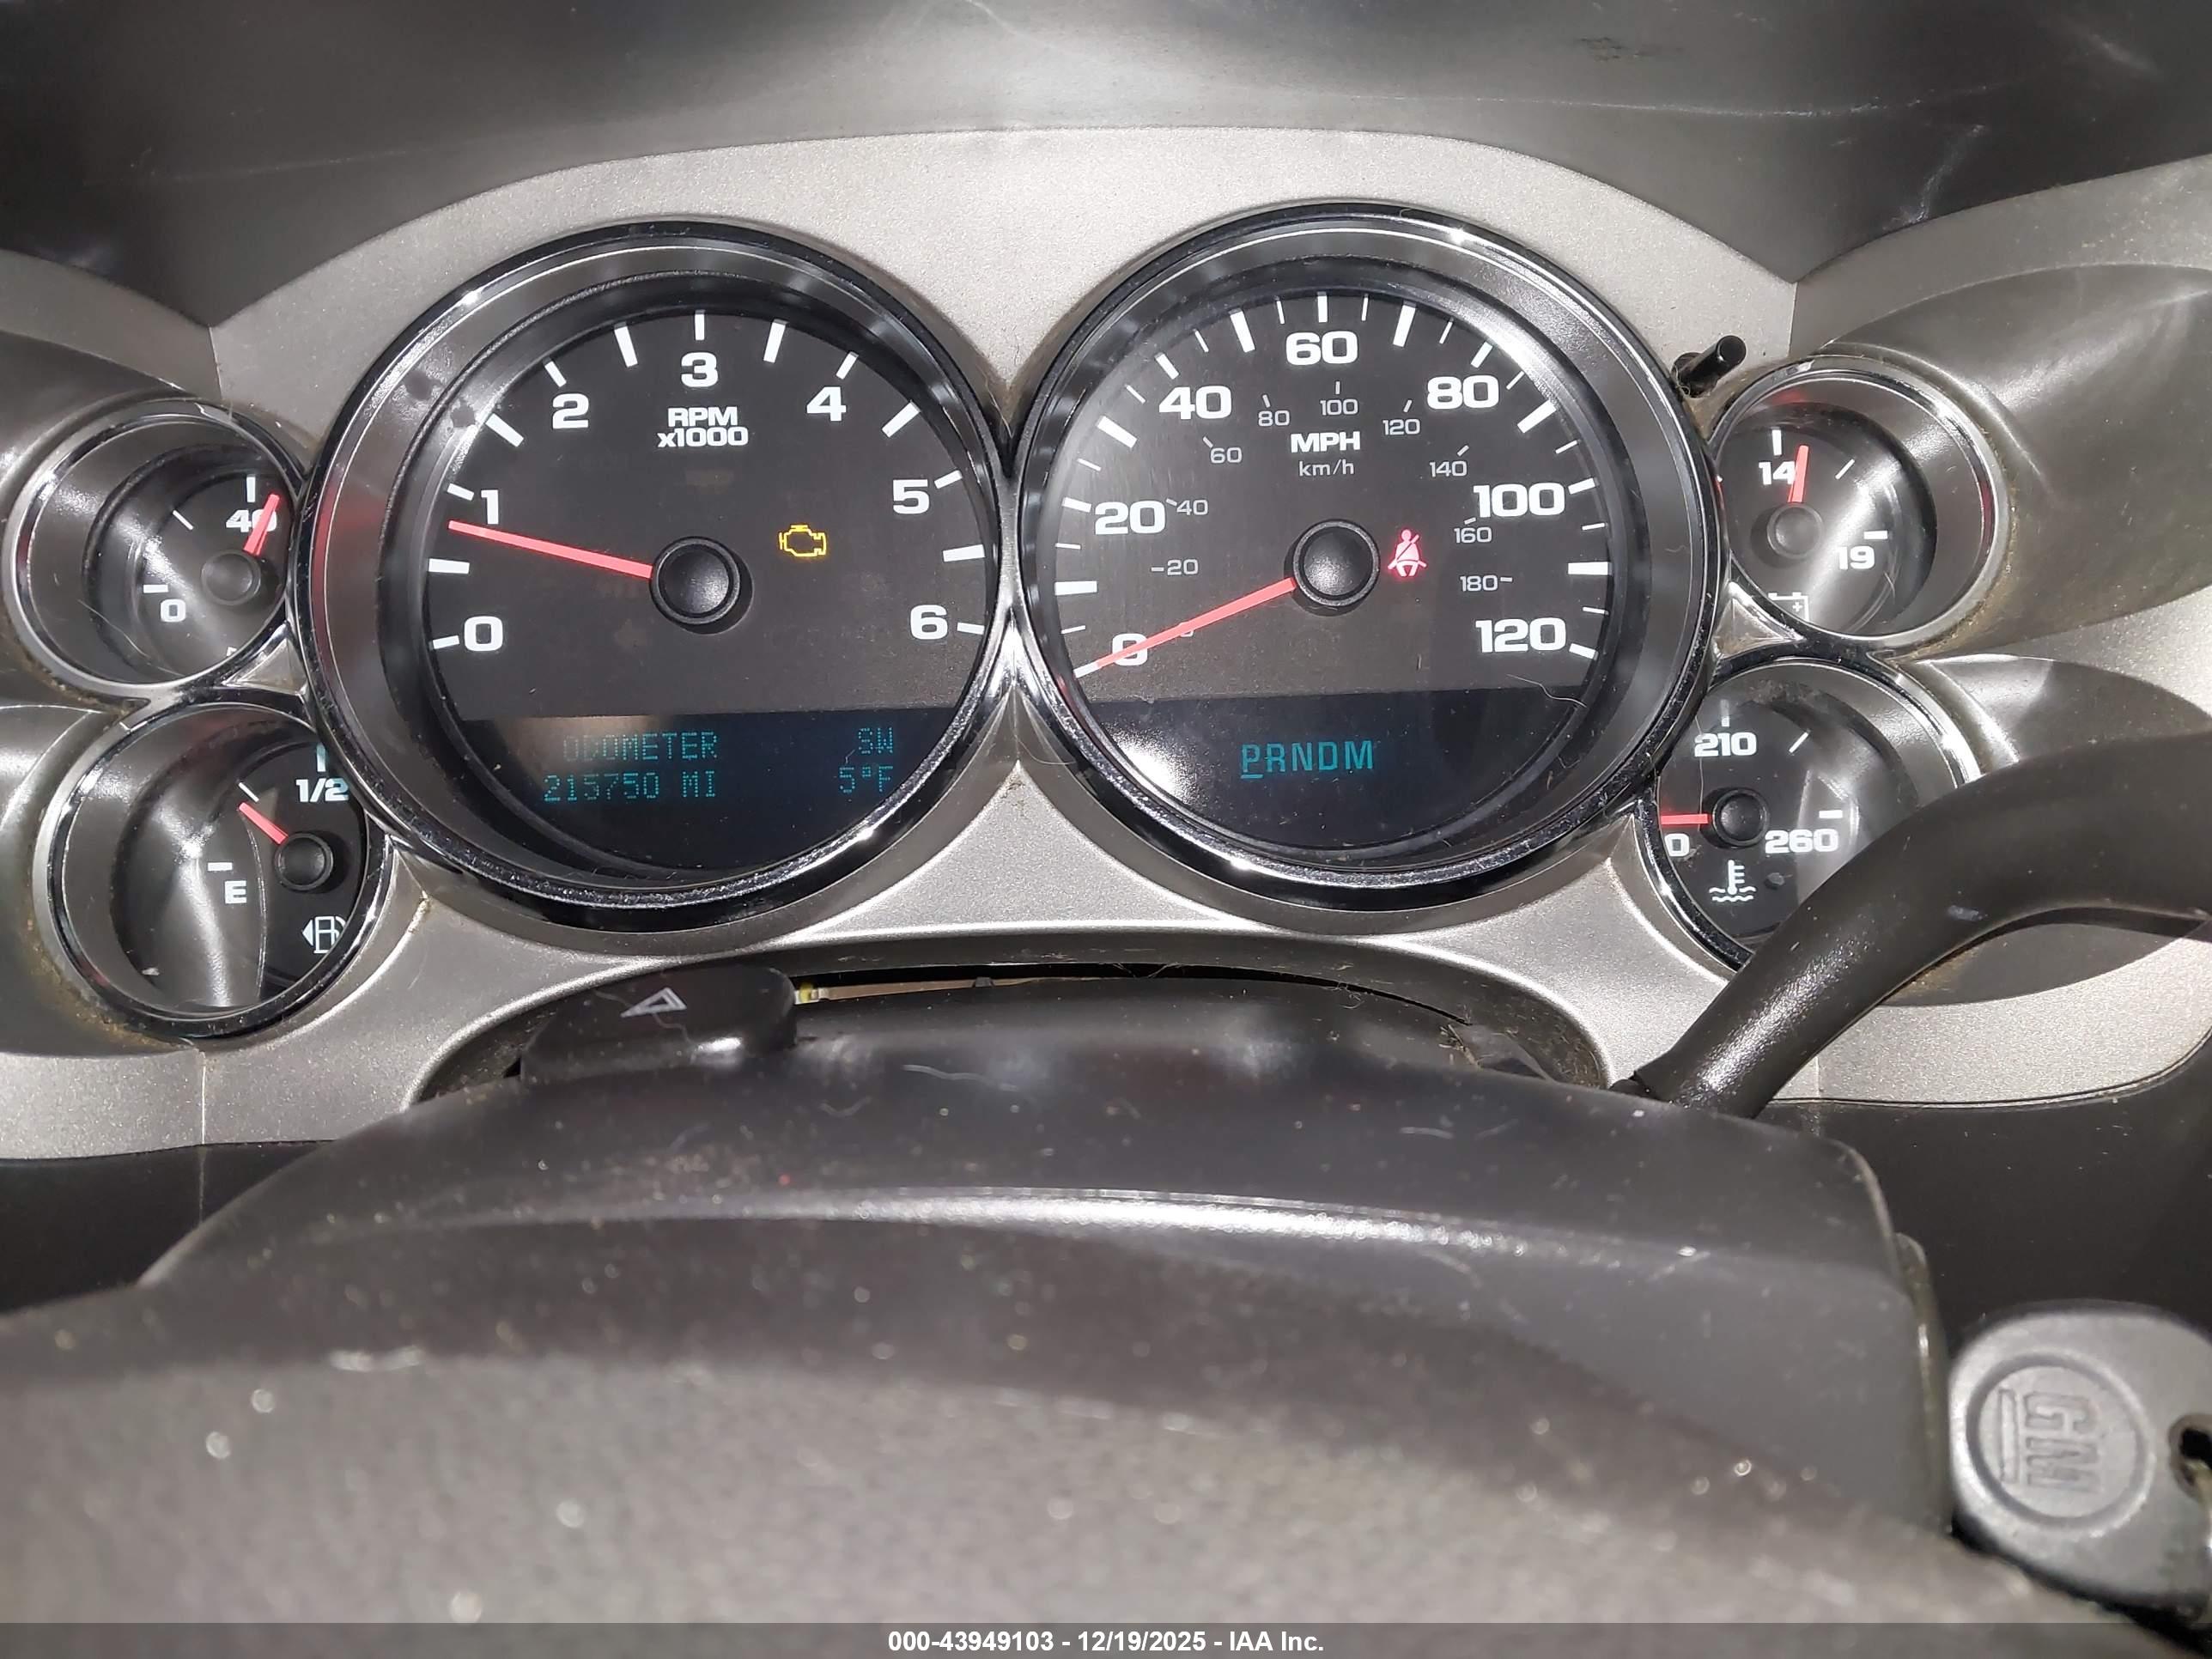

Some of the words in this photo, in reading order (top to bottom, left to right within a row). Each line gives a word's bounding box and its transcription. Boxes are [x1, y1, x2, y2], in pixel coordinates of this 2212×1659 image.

[1286, 331, 1358, 365] 60
[681, 352, 718, 387] 3
[806, 386, 846, 422] 4
[1158, 386, 1231, 418] 40
[1427, 374, 1499, 409] 80
[552, 393, 589, 428] 2
[668, 407, 738, 426] RPM
[1258, 410, 1290, 426] 80
[1320, 398, 1358, 416] 100
[657, 426, 748, 447] x1000
[1382, 419, 1420, 435] 120
[1291, 432, 1360, 453] MPH
[1211, 447, 1242, 464] 60
[1299, 459, 1354, 477] km/h
[1430, 461, 1467, 477] 140
[1759, 460, 1796, 485] 14
[481, 489, 499, 524] 1
[893, 479, 930, 514] 5
[1177, 500, 1208, 516] 40
[1474, 483, 1565, 518] 100
[1095, 500, 1165, 534] 20
[1454, 526, 1492, 544] 160
[1167, 559, 1198, 575] 20
[1837, 545, 1875, 570] 19
[1460, 574, 1498, 592] 180
[161, 599, 186, 623] 0
[909, 605, 947, 640] 6
[464, 617, 503, 652] 0
[1475, 617, 1565, 653] 120
[1112, 633, 1147, 666] 0
[562, 732, 718, 762] ODOMETER
[859, 726, 893, 754] SW
[1694, 732, 1757, 757] 210
[1242, 740, 1374, 774] PRNDM
[296, 777, 349, 803] 1/2
[544, 772, 659, 801] 215750
[682, 770, 716, 798] MI
[1765, 829, 1839, 854] 260
[225, 880, 247, 904] E
